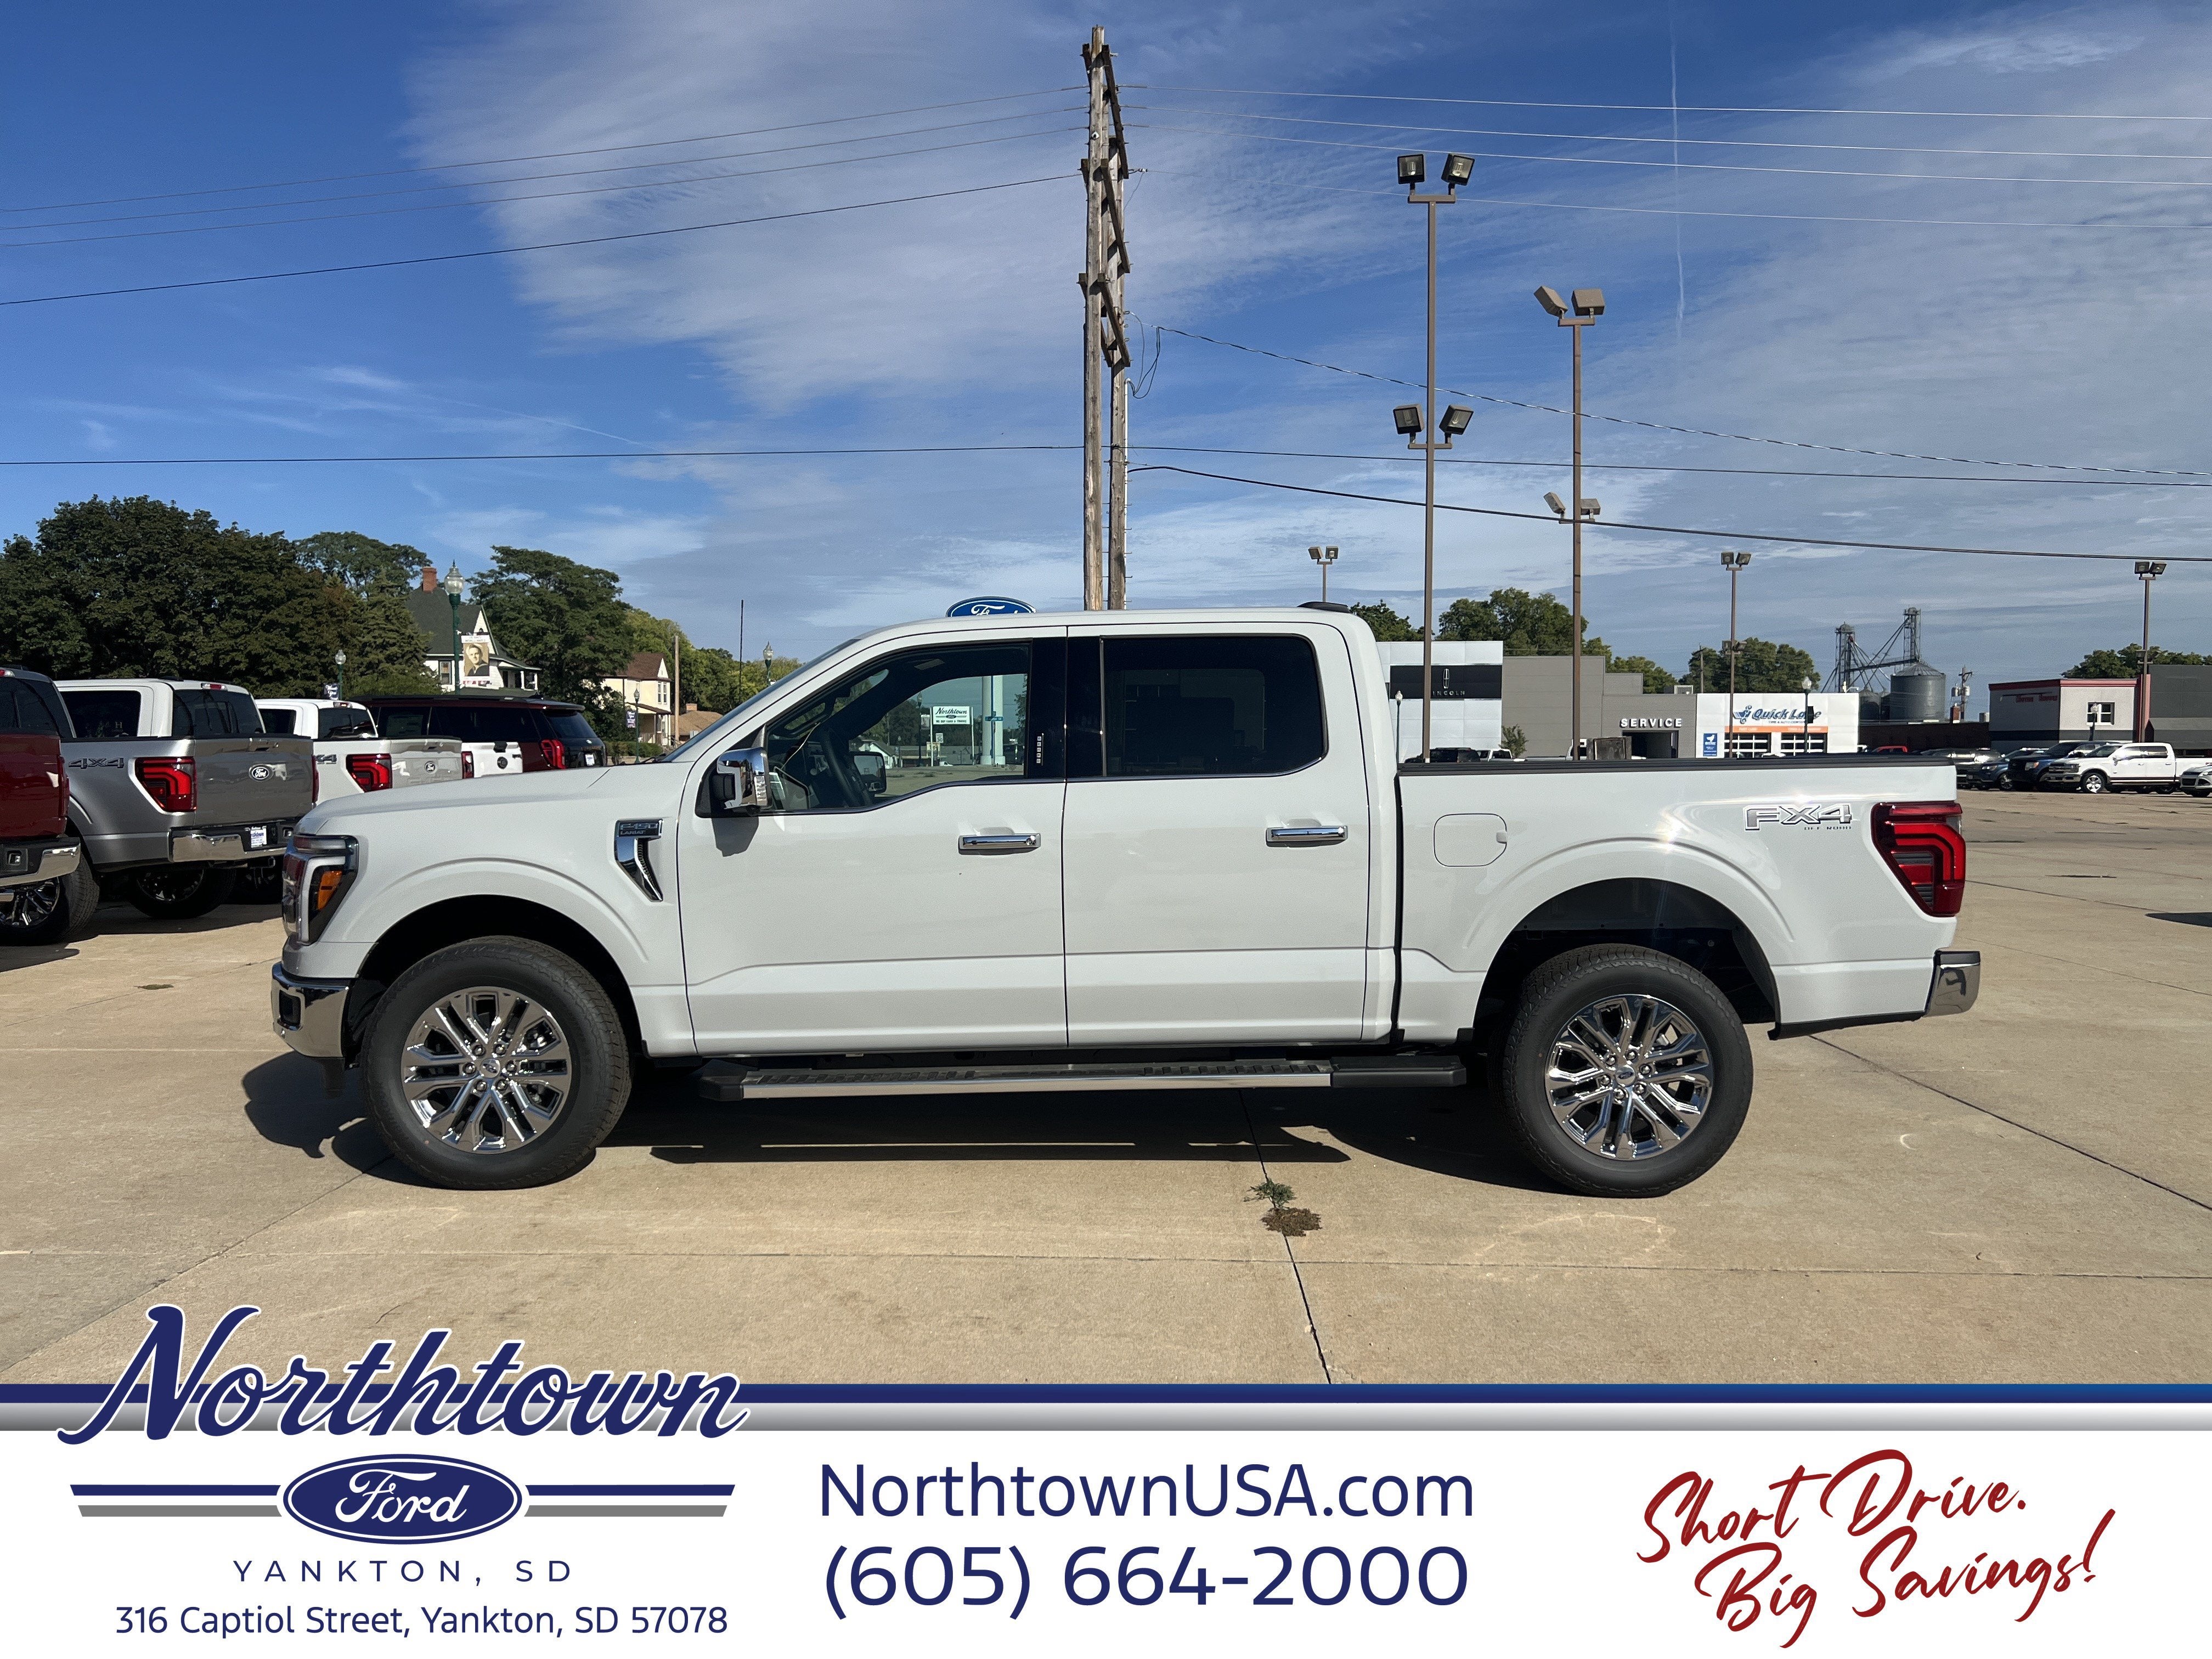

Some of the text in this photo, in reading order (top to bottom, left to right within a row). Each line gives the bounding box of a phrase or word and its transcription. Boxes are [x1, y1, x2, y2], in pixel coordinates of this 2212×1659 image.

[1752, 709, 1789, 720] Quick
[1620, 718, 1683, 728] SERVICE
[1743, 803, 1852, 831] FX4
